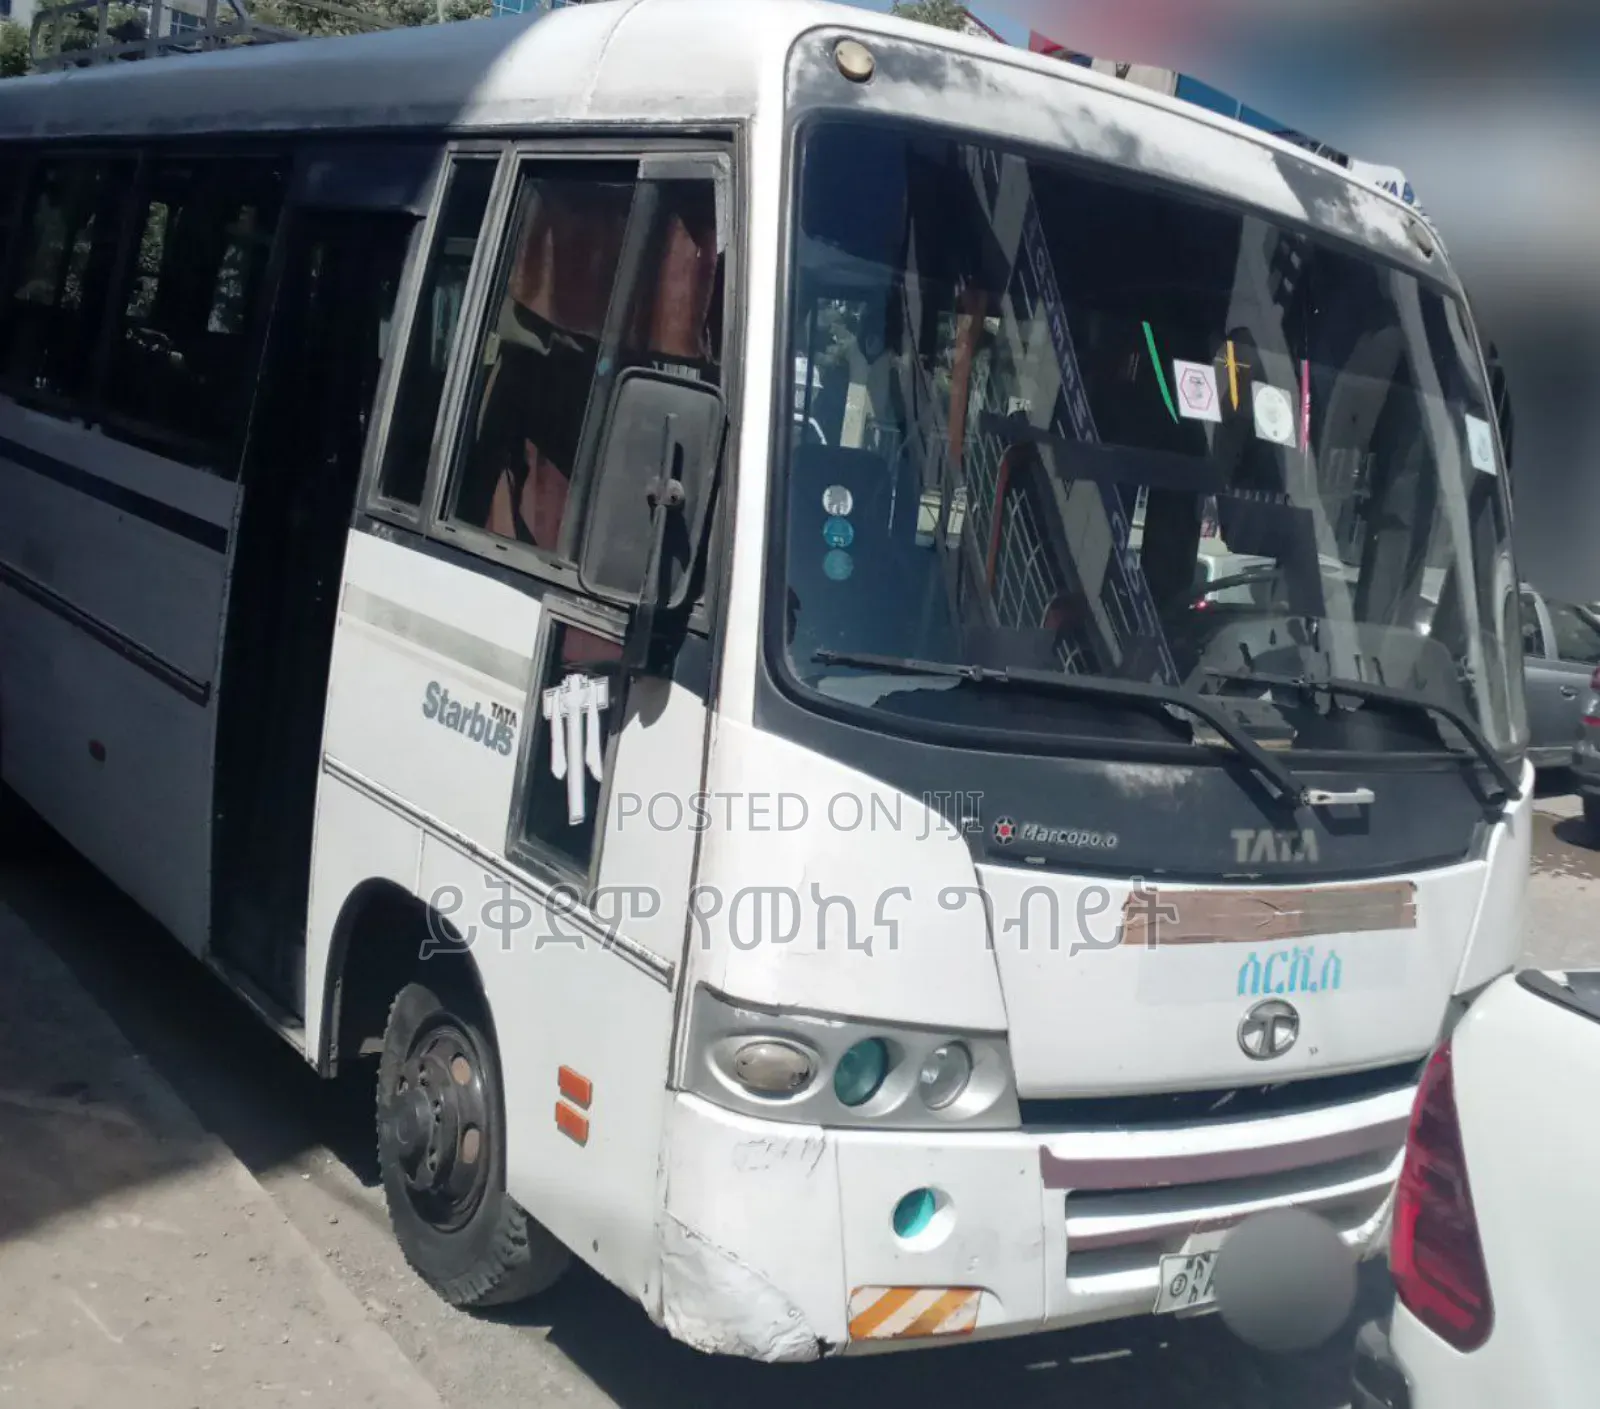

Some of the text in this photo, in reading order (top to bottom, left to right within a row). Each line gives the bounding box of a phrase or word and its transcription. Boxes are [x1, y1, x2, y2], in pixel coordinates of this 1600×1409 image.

[422, 680, 515, 756] Starbus
[491, 702, 517, 728] TATA
[1021, 823, 1119, 848] Marcopoo
[1230, 829, 1320, 863] TATA
